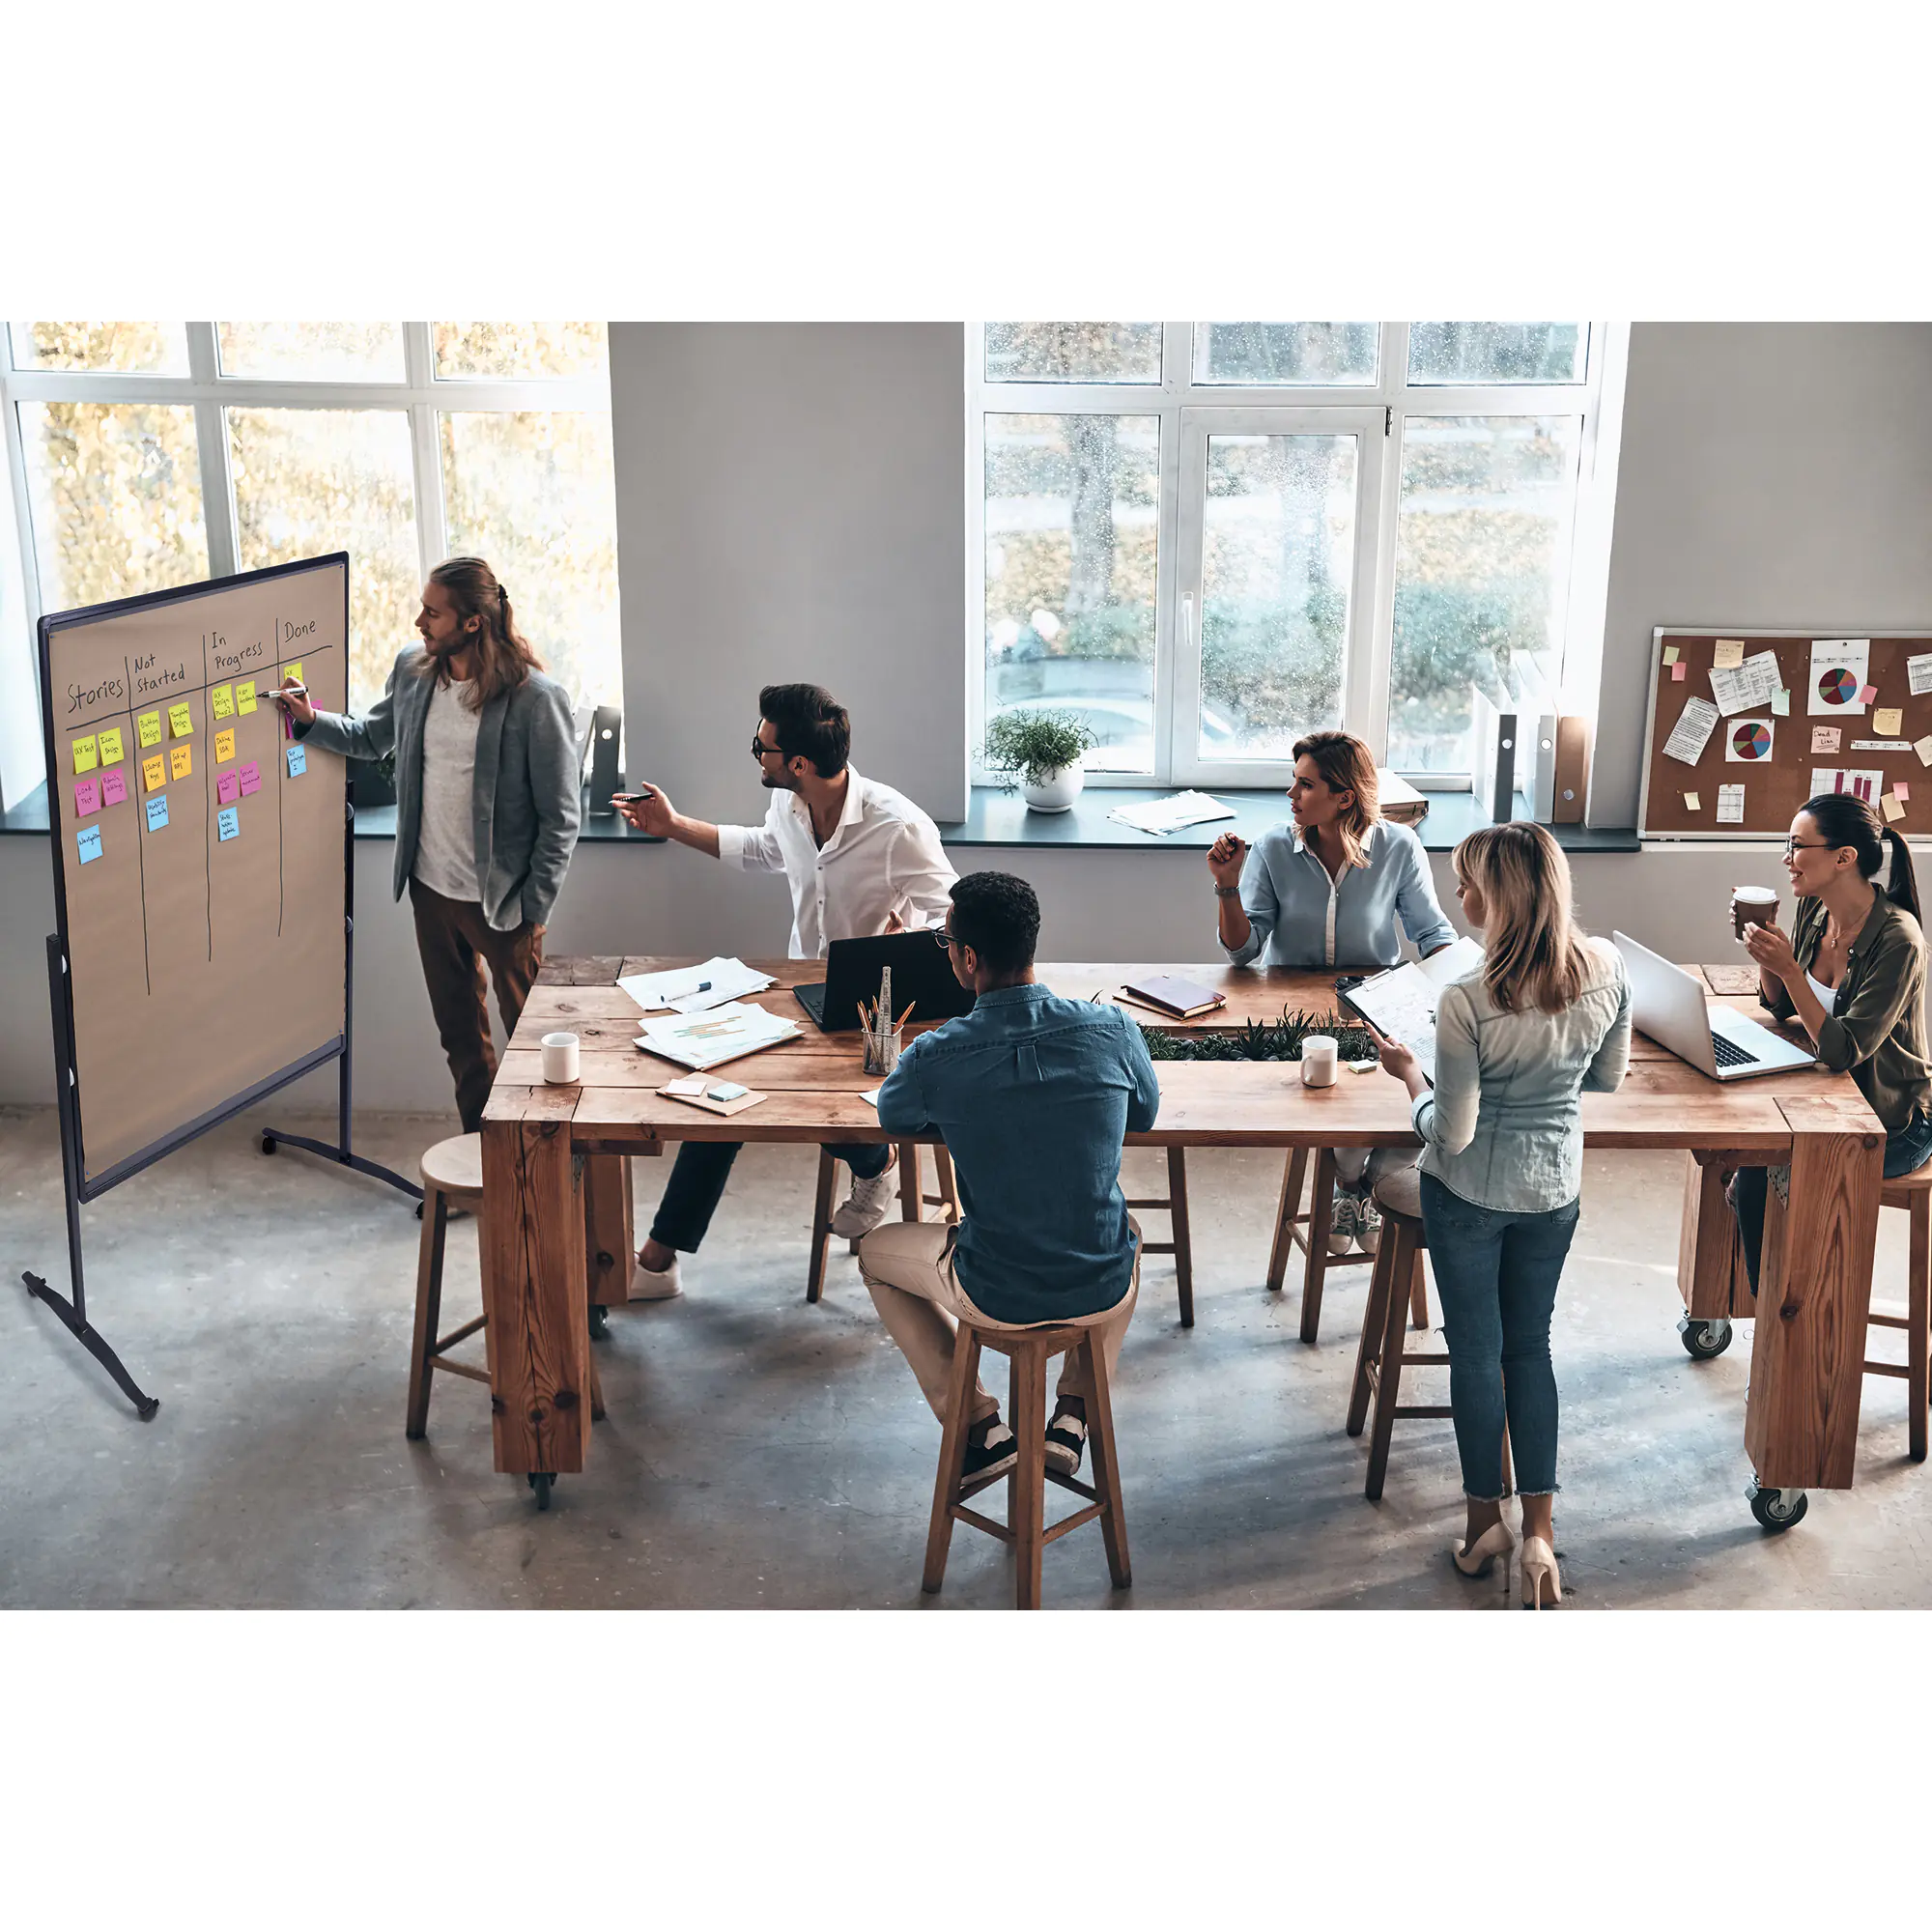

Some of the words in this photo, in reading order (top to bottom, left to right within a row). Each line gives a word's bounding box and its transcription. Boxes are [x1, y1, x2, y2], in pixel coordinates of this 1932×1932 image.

[212, 631, 227, 649] In
[284, 619, 316, 643] Done
[134, 654, 156, 673] Not
[215, 641, 263, 672] Progress
[68, 678, 124, 713] Stories
